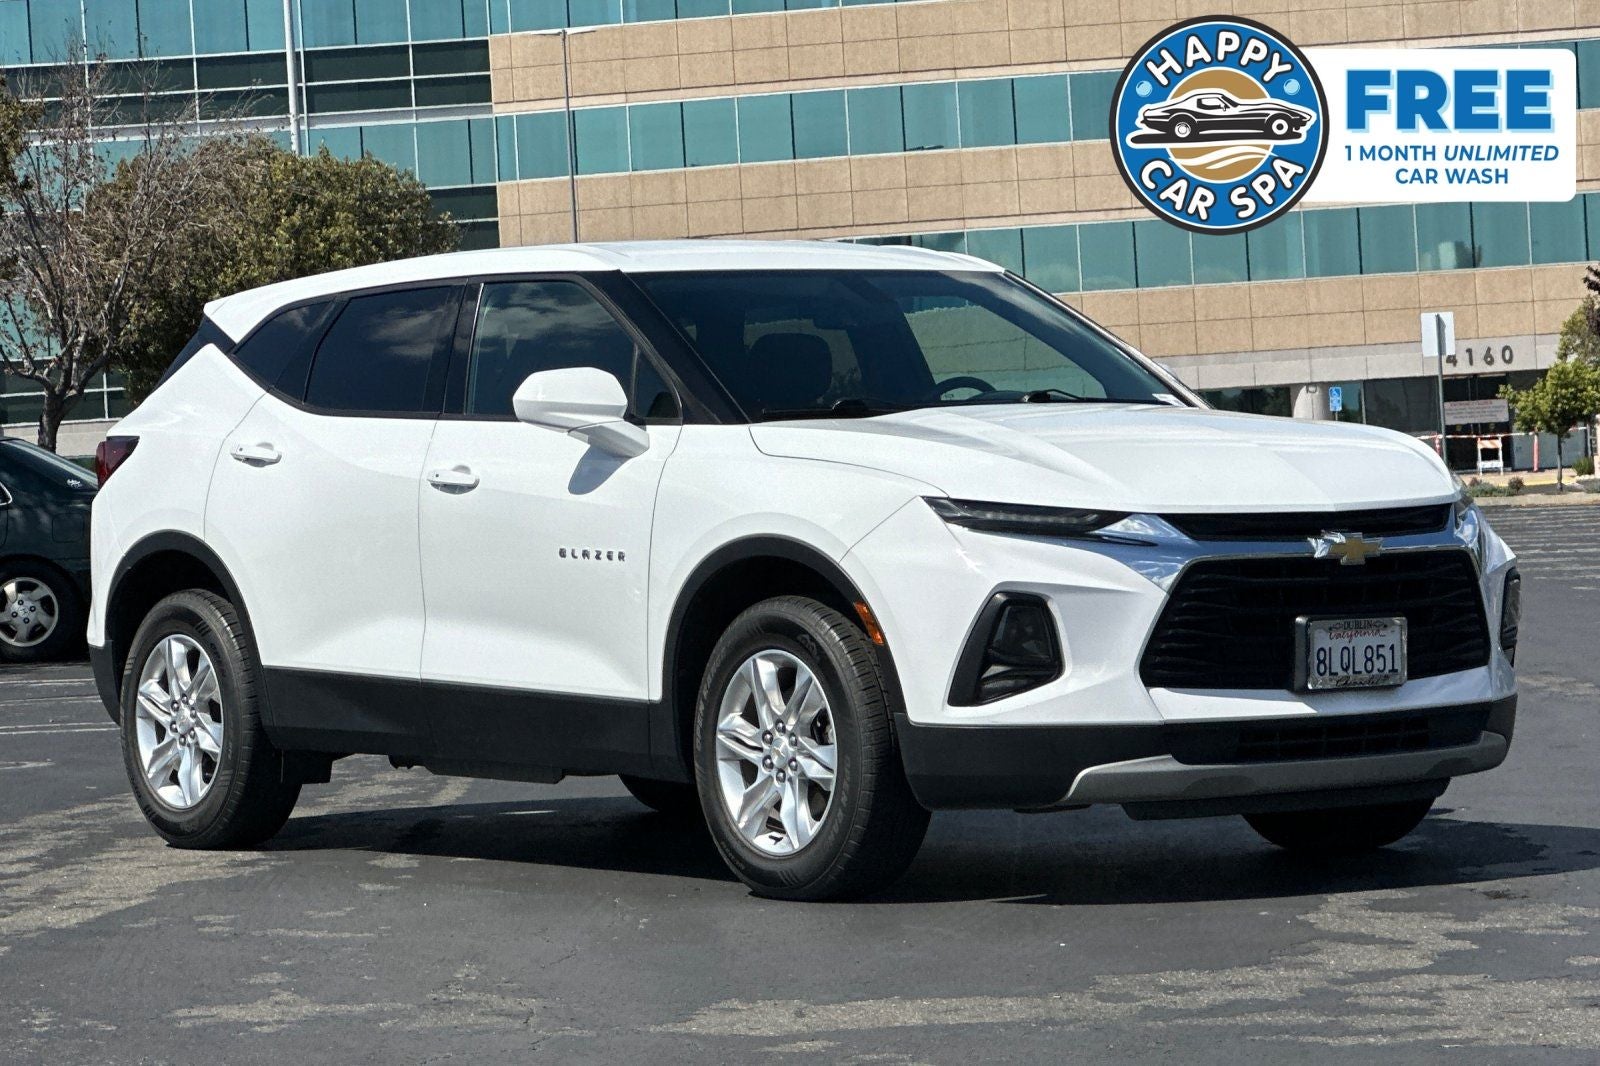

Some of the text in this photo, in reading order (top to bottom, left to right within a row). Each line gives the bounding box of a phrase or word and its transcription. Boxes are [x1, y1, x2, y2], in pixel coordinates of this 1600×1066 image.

[1446, 345, 1514, 368] 4160
[558, 548, 625, 561] BLAZER
[1343, 619, 1374, 630] DUBLIN
[1329, 629, 1385, 643] California
[1316, 643, 1399, 676] 8LQL851
